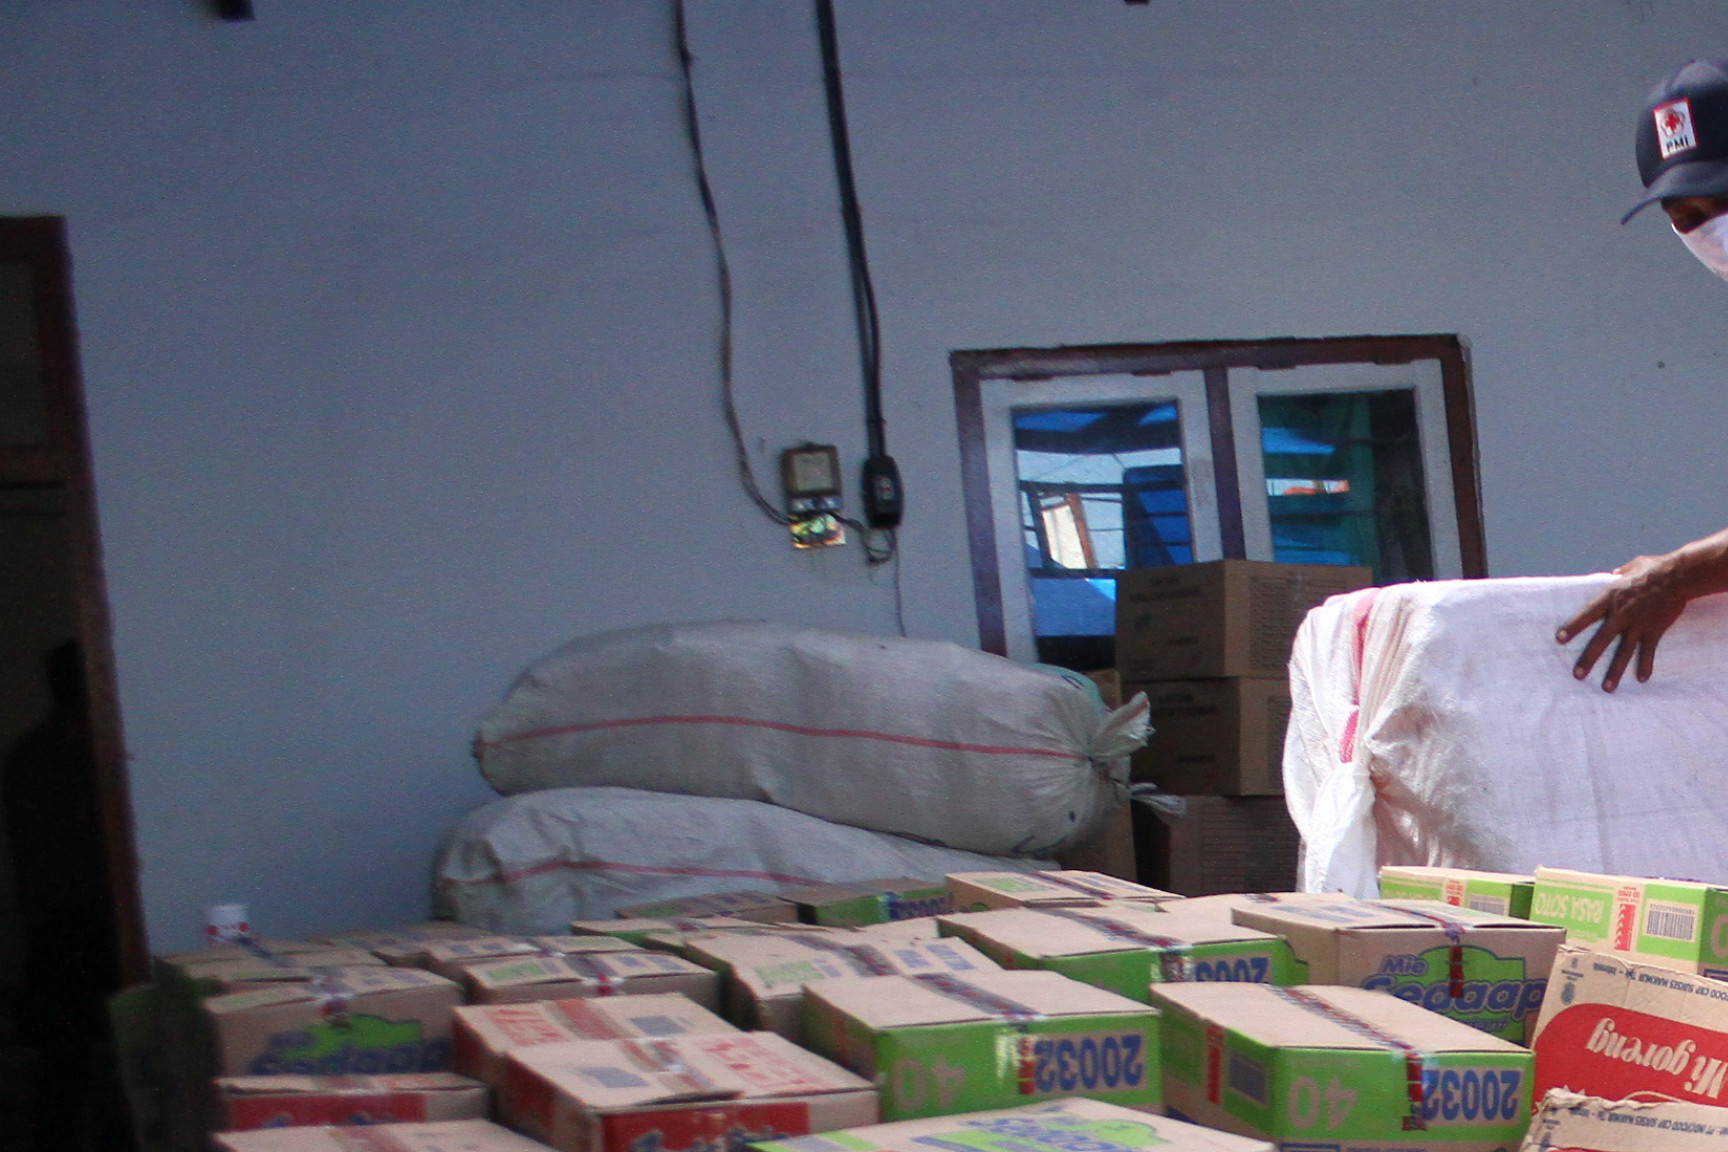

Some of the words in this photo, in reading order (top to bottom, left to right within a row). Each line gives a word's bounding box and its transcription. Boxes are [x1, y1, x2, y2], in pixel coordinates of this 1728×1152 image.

[1666, 135, 1690, 152] PMI
[1381, 954, 1430, 977] Mie
[1033, 1034, 1143, 1093] 20032
[1585, 1017, 1699, 1077] goreng
[893, 1056, 967, 1110] 40
[1288, 1075, 1359, 1130] 40
[1421, 1069, 1522, 1121] 20032
